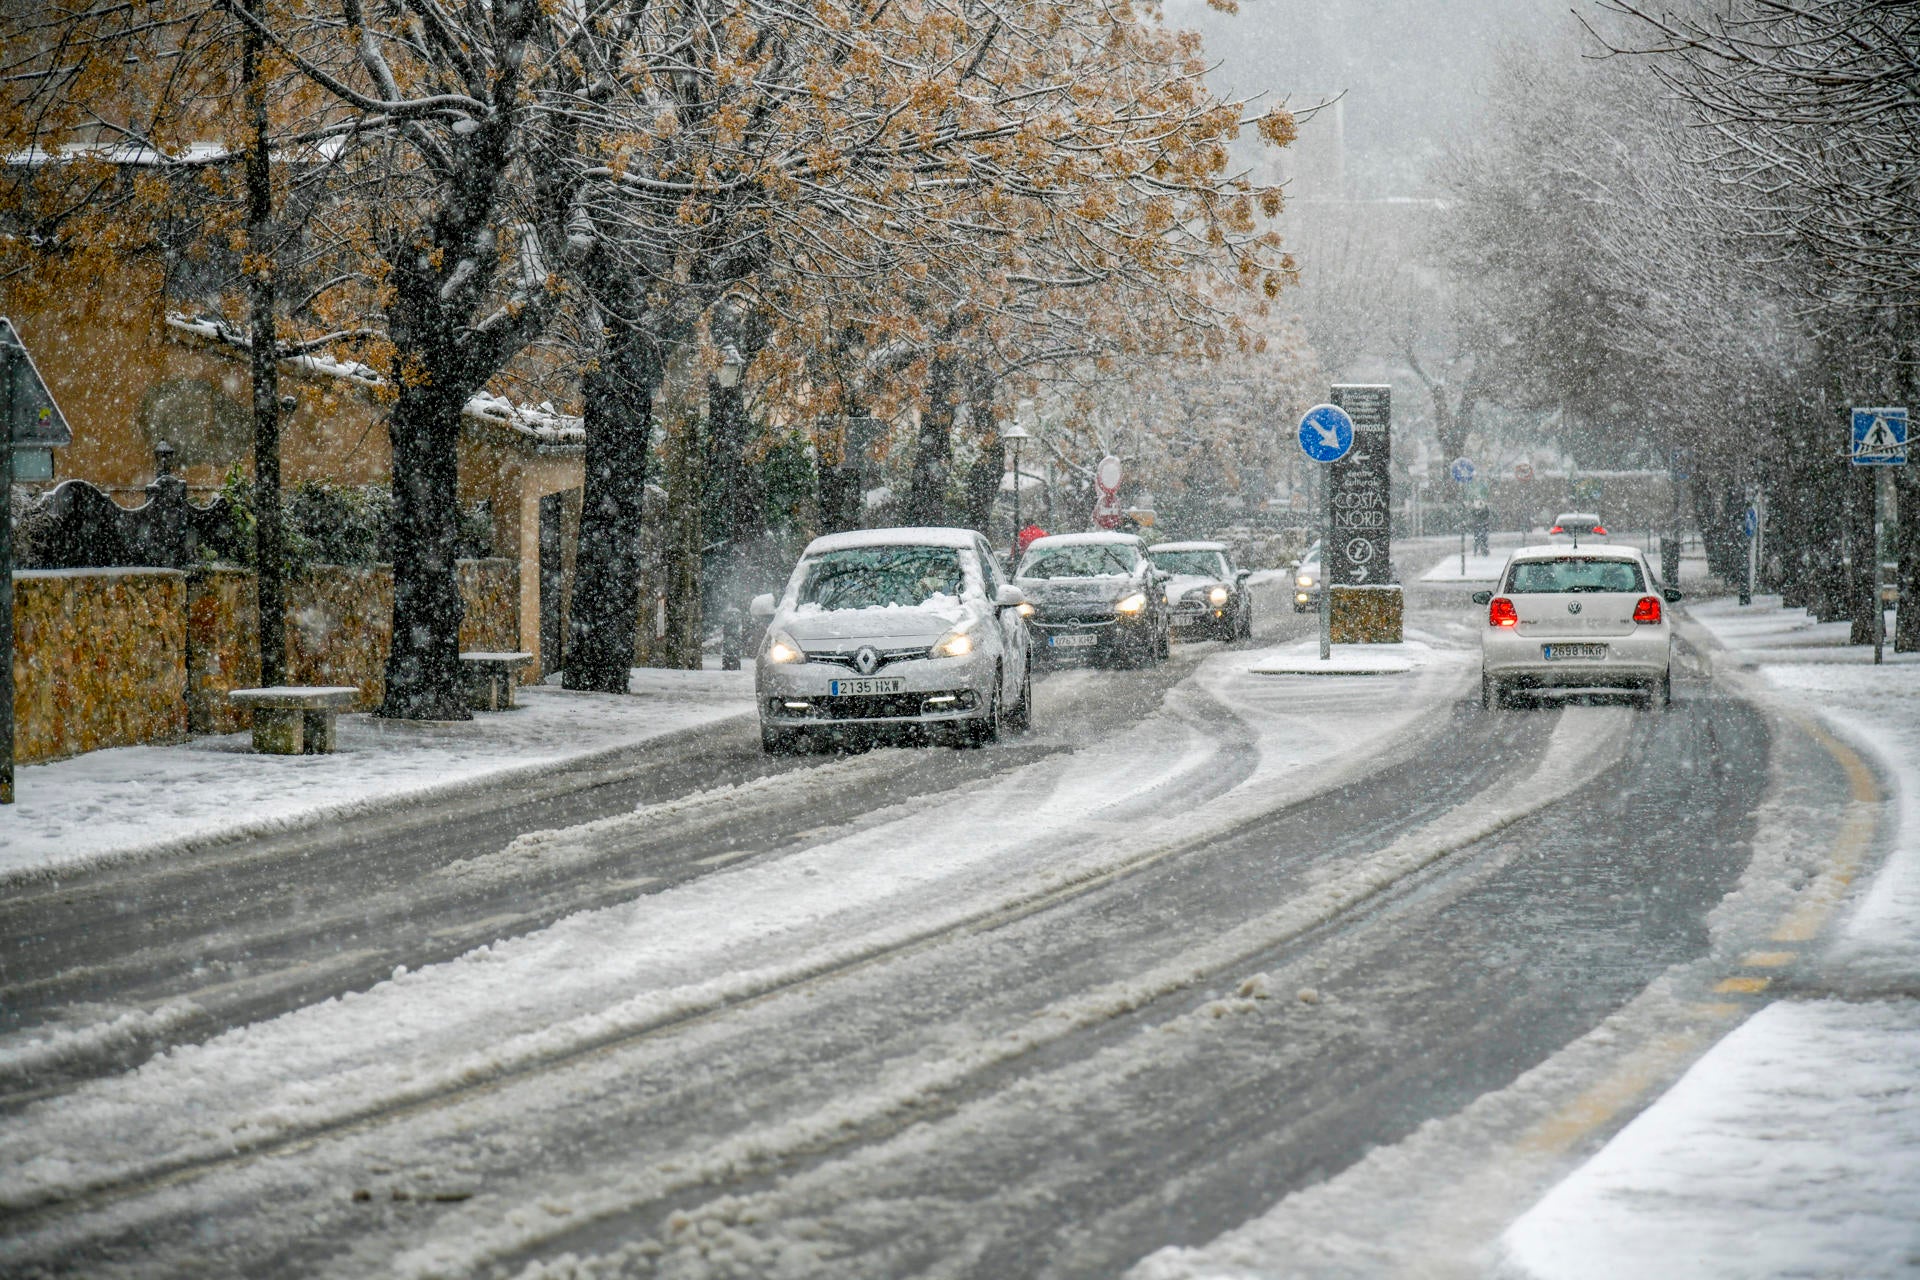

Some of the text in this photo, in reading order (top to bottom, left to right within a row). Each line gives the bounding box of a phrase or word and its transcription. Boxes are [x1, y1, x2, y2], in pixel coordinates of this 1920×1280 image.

[1335, 491, 1386, 509] COSTA
[1335, 510, 1384, 527] NORD
[1552, 646, 1602, 656] 2698 HKR
[840, 680, 899, 694] 2135 HXW
